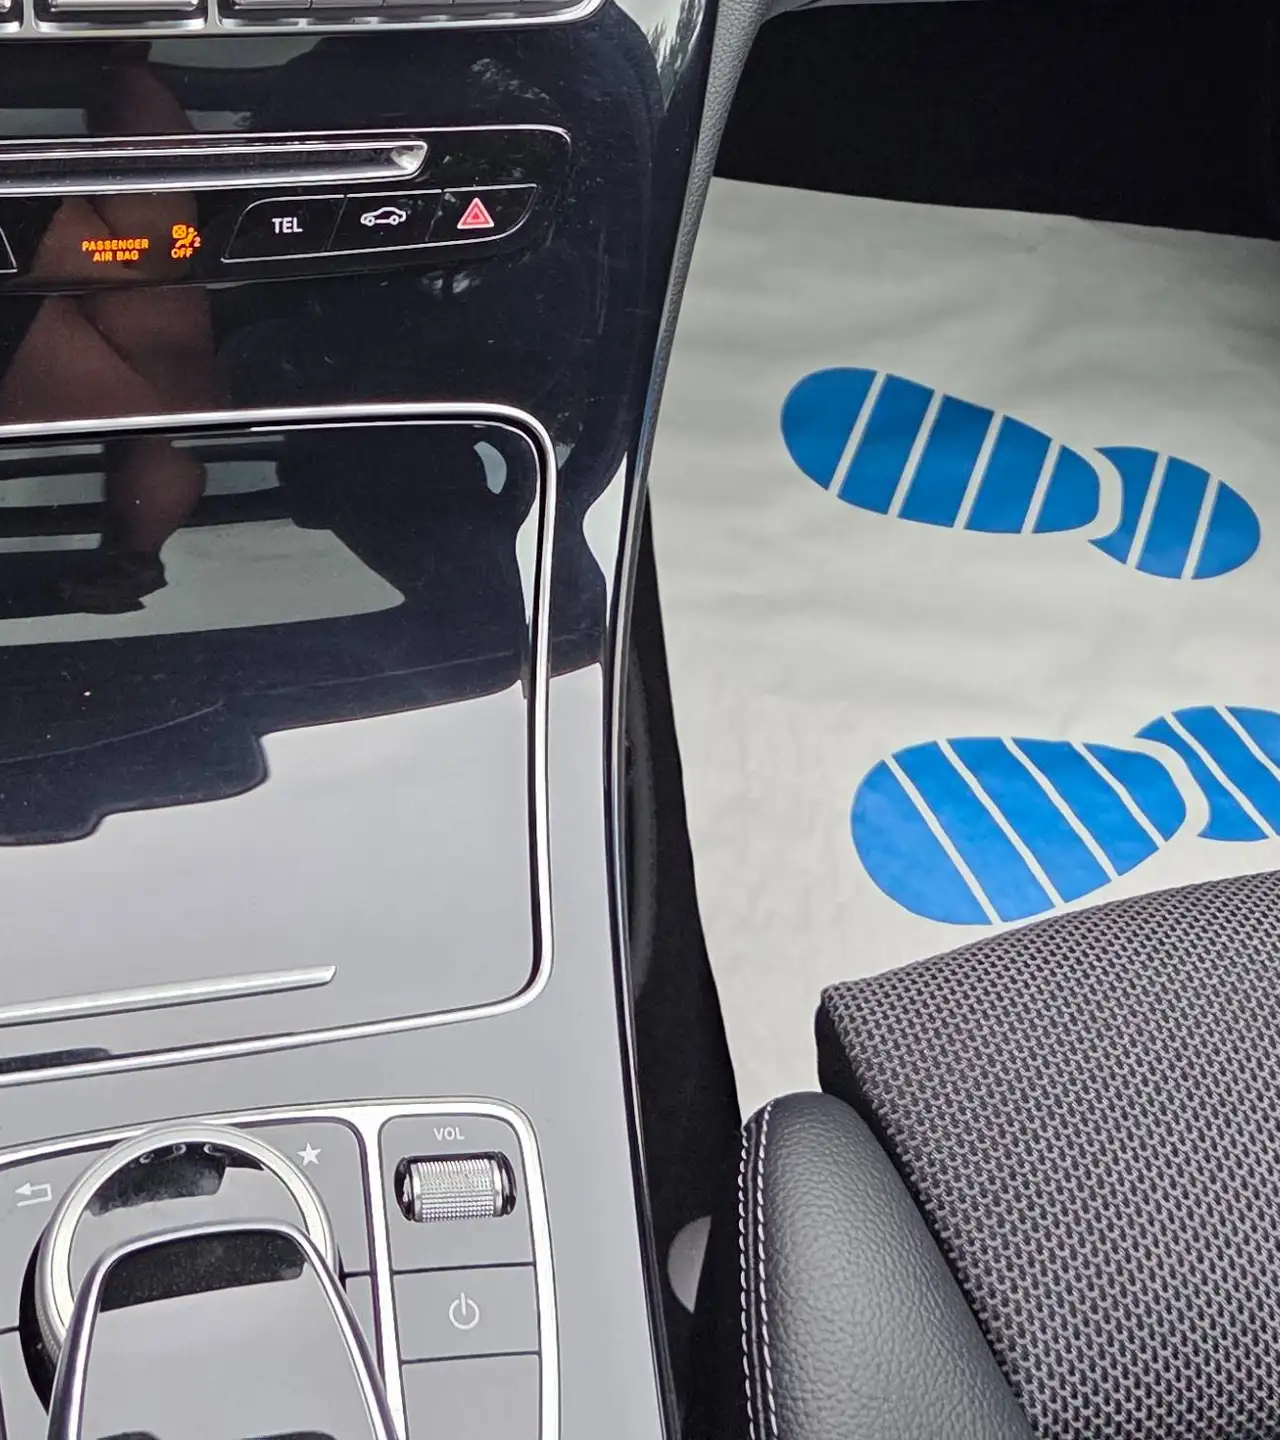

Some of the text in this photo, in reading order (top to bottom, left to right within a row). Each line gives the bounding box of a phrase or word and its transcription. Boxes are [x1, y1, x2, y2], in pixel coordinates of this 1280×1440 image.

[272, 217, 303, 235] TEL
[82, 238, 149, 252] PASSENGER
[93, 251, 113, 262] AIR
[171, 247, 193, 259] OFF
[433, 1125, 466, 1142] VOL
